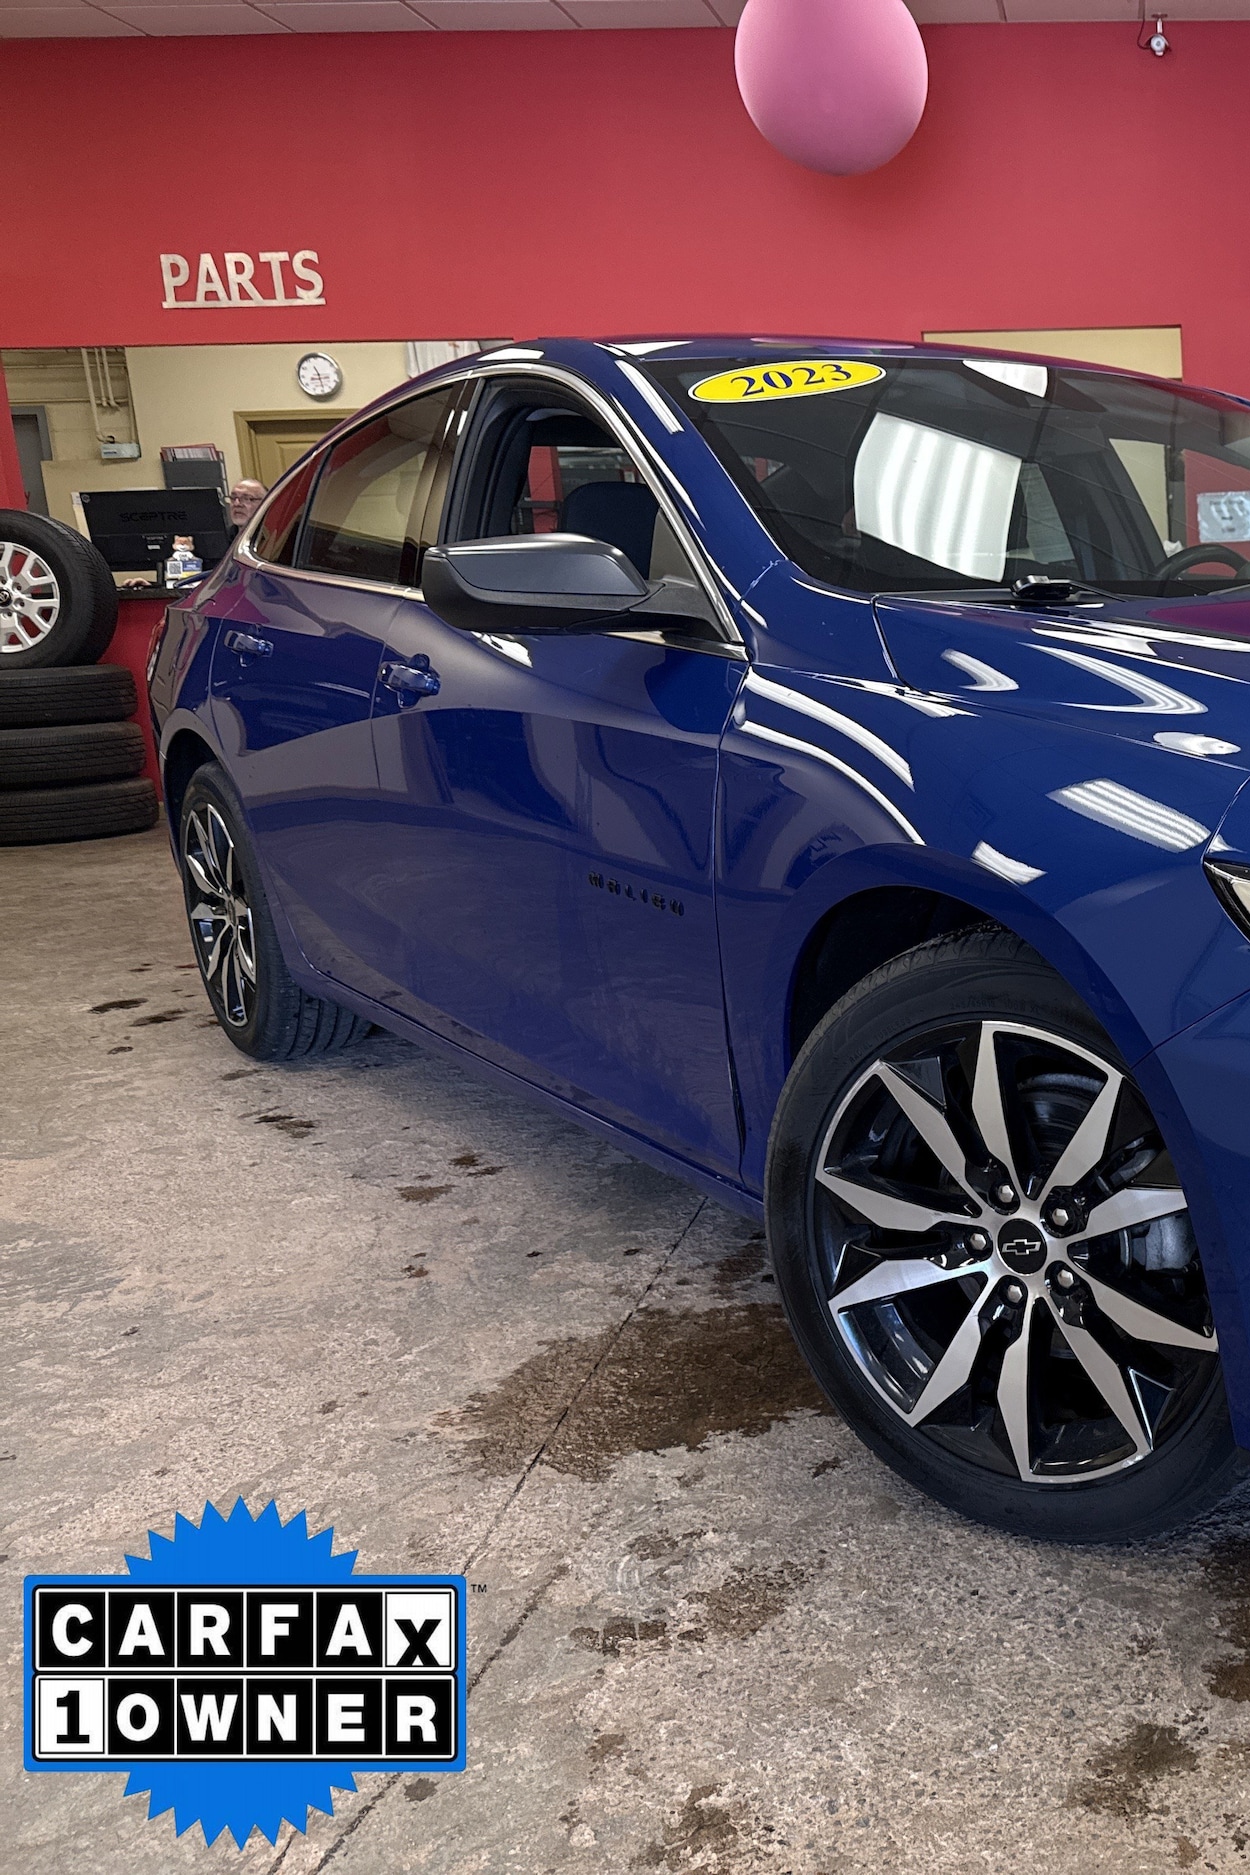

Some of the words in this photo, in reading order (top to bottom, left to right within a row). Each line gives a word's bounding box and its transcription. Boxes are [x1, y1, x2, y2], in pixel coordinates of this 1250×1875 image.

[160, 250, 325, 302] PARTS
[731, 363, 852, 397] 2023
[119, 511, 189, 522] SCEPTRE
